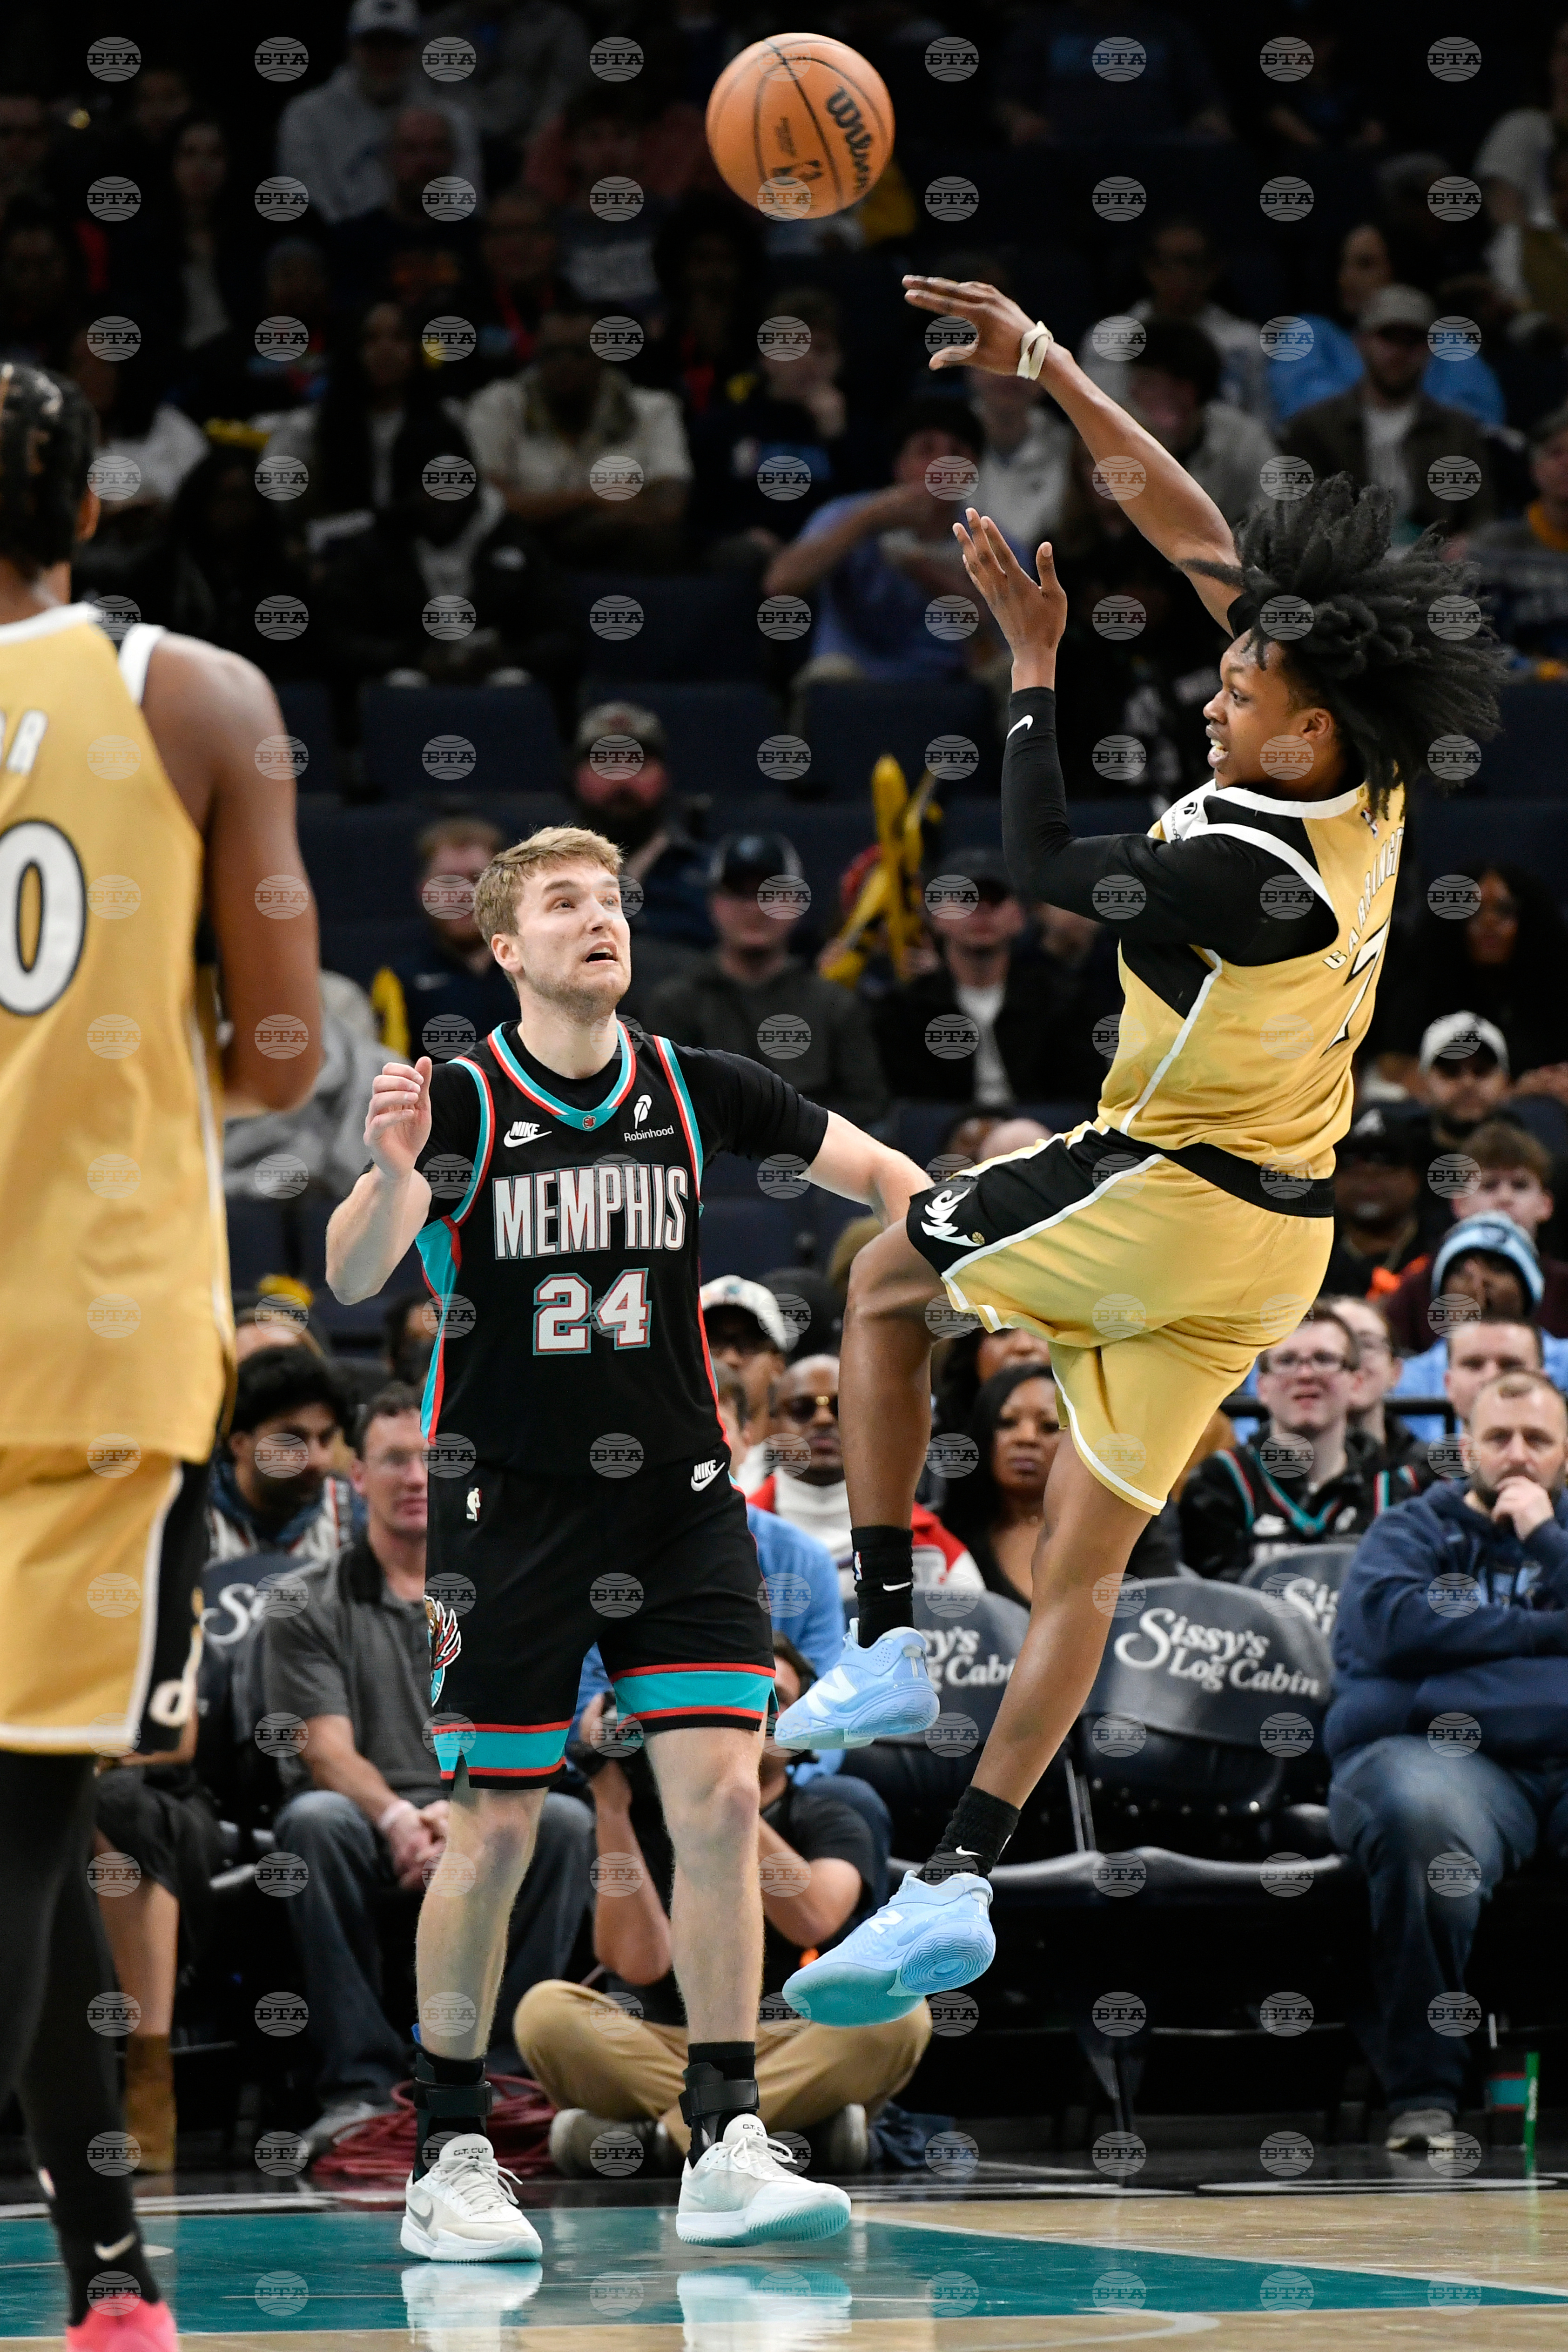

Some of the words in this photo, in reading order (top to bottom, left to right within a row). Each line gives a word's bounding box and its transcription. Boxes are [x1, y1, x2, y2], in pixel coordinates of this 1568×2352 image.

[1319, 915, 1391, 1059] 7
[510, 1121, 540, 1137] NIKE
[624, 1125, 674, 1142] Robinhood
[492, 1164, 688, 1260] MEMPHIS
[532, 1268, 652, 1355] 24
[694, 1459, 716, 1481] NIKE
[921, 1626, 980, 1665] sy's
[1114, 1607, 1270, 1670] Sissy's
[945, 1653, 1016, 1686] Cab
[1168, 1648, 1224, 1692] Log
[1229, 1658, 1320, 1696] Cabin
